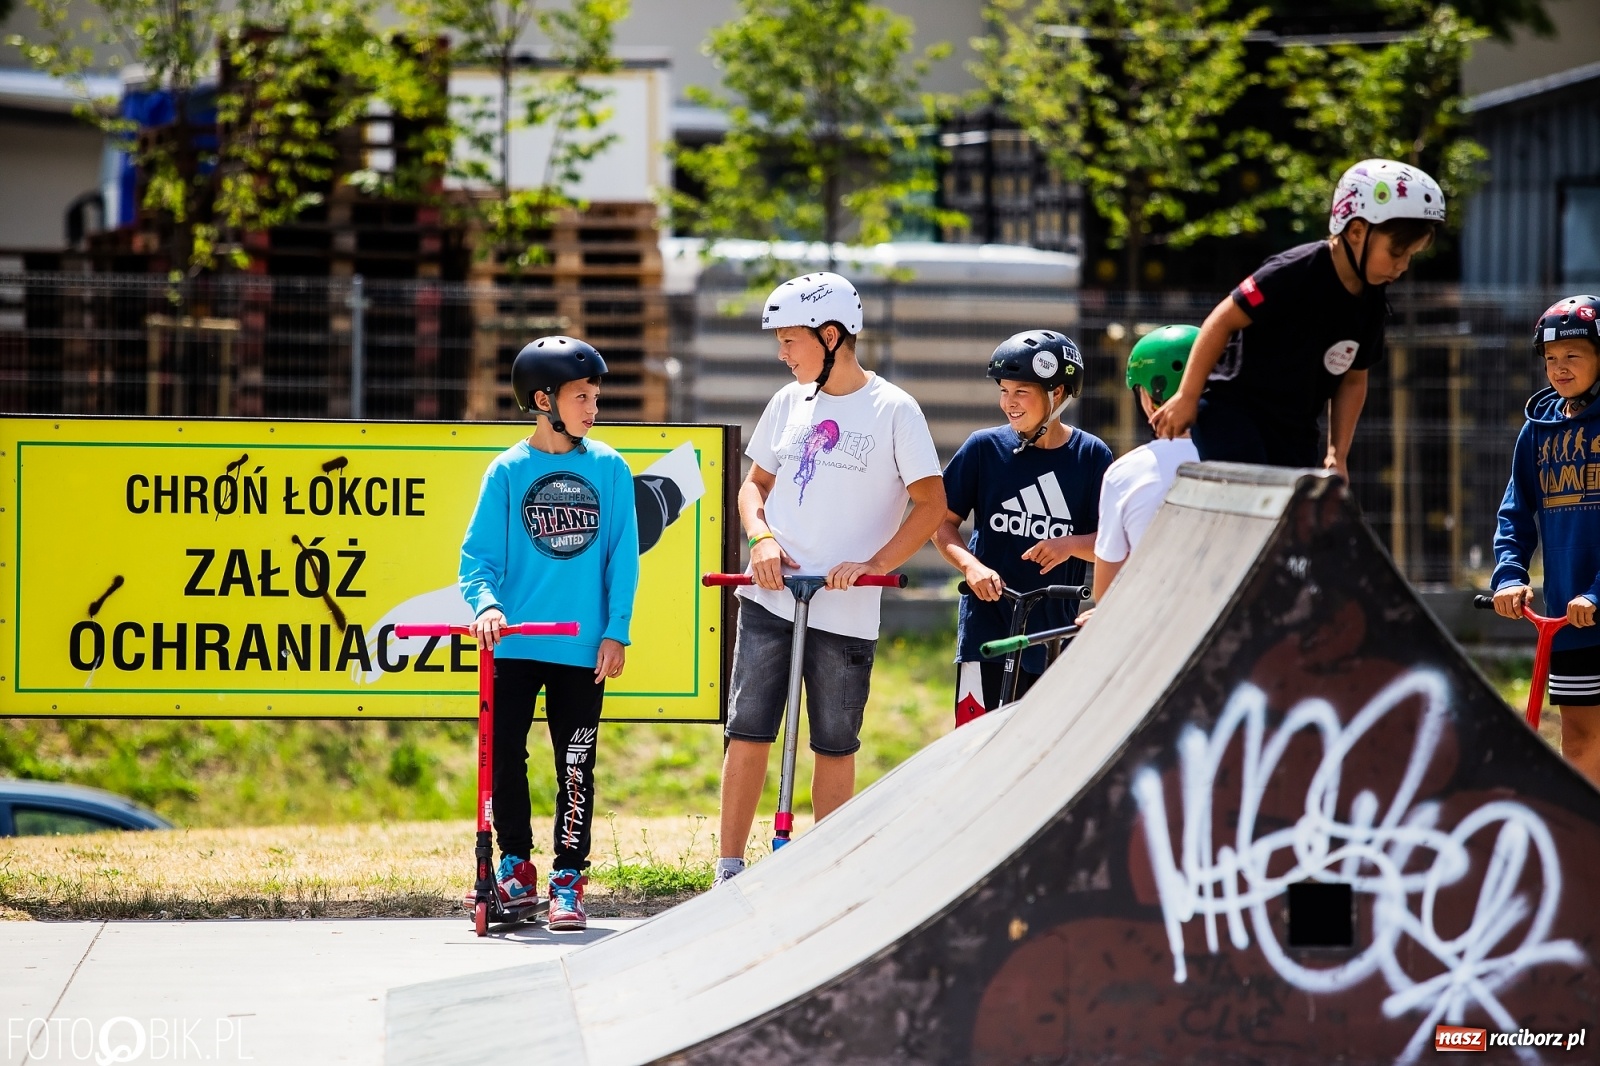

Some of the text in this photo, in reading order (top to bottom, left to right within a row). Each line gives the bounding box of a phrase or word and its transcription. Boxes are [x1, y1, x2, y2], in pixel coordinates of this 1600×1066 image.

[1559, 328, 1588, 337] PSYCHOTIC
[821, 460, 868, 473] MAGAZINE
[126, 465, 426, 516] CHROŃ ŁOKCIE
[539, 493, 586, 502] TOGETHER
[525, 506, 600, 538] STAND
[551, 534, 584, 548] UNITED
[184, 536, 367, 598] ZAŁÓŻ
